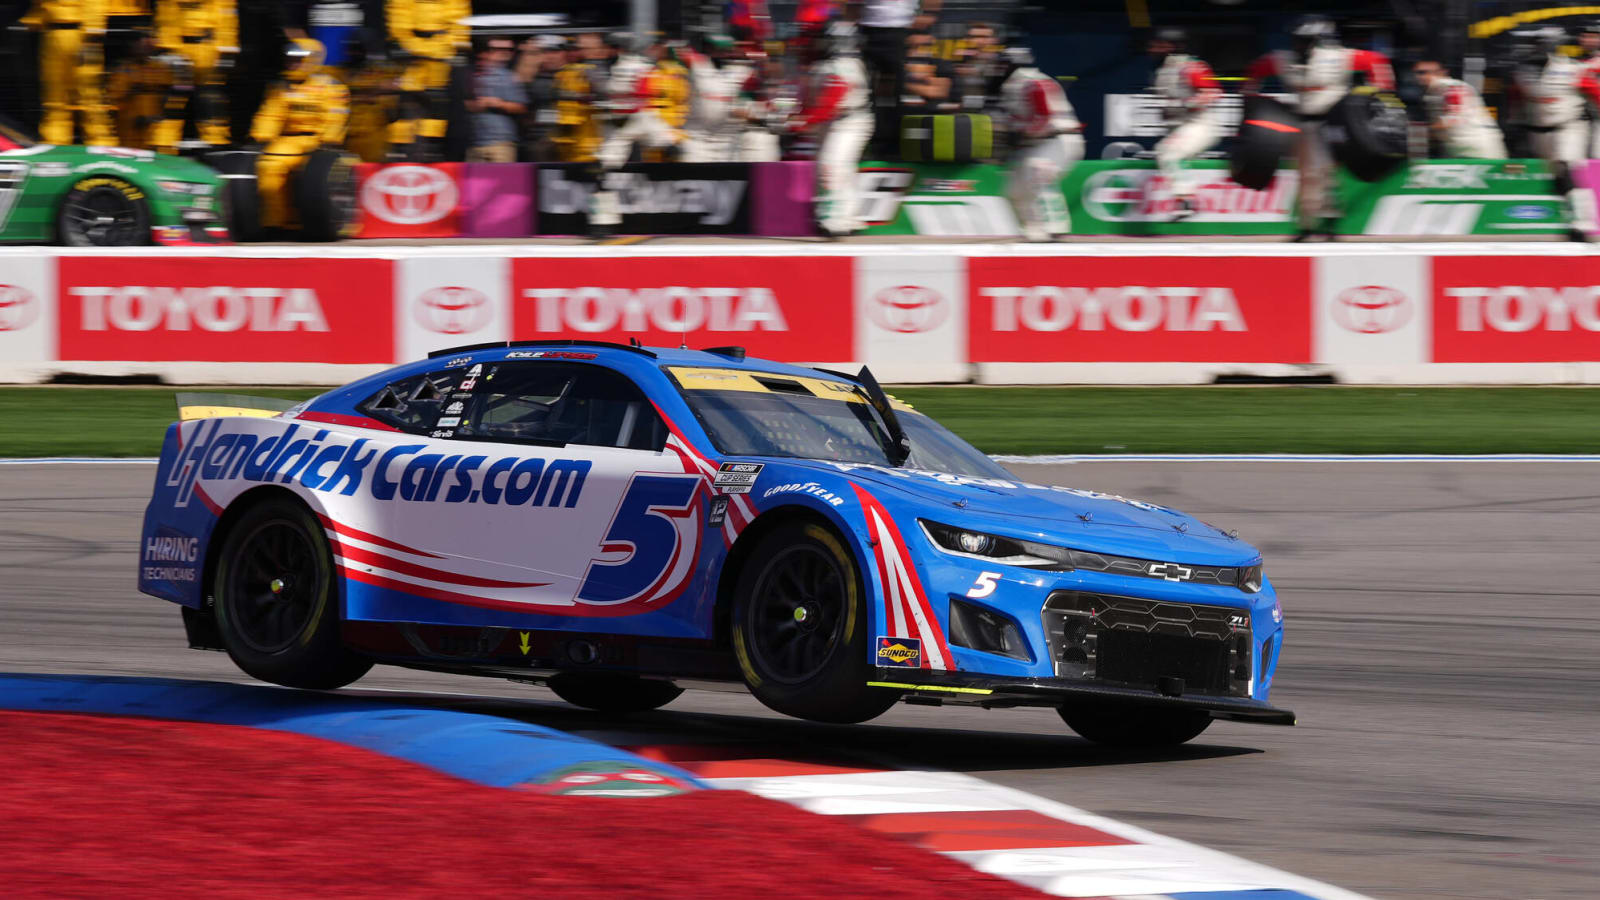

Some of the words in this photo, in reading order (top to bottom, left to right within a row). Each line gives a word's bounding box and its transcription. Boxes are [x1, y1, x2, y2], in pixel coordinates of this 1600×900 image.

[69, 286, 330, 332] TOYOTA
[523, 286, 787, 332] TOYOTA
[980, 286, 1246, 332] TOYOTA
[166, 419, 592, 508] HendrickCars.com
[720, 474, 733, 482] CUP
[763, 482, 845, 506] GOODYEAR
[145, 536, 199, 562] HIRING
[573, 472, 706, 608] 5
[143, 566, 196, 581] TECHNICIANS
[966, 571, 1002, 598] 5
[879, 648, 917, 658] SUNOCO
